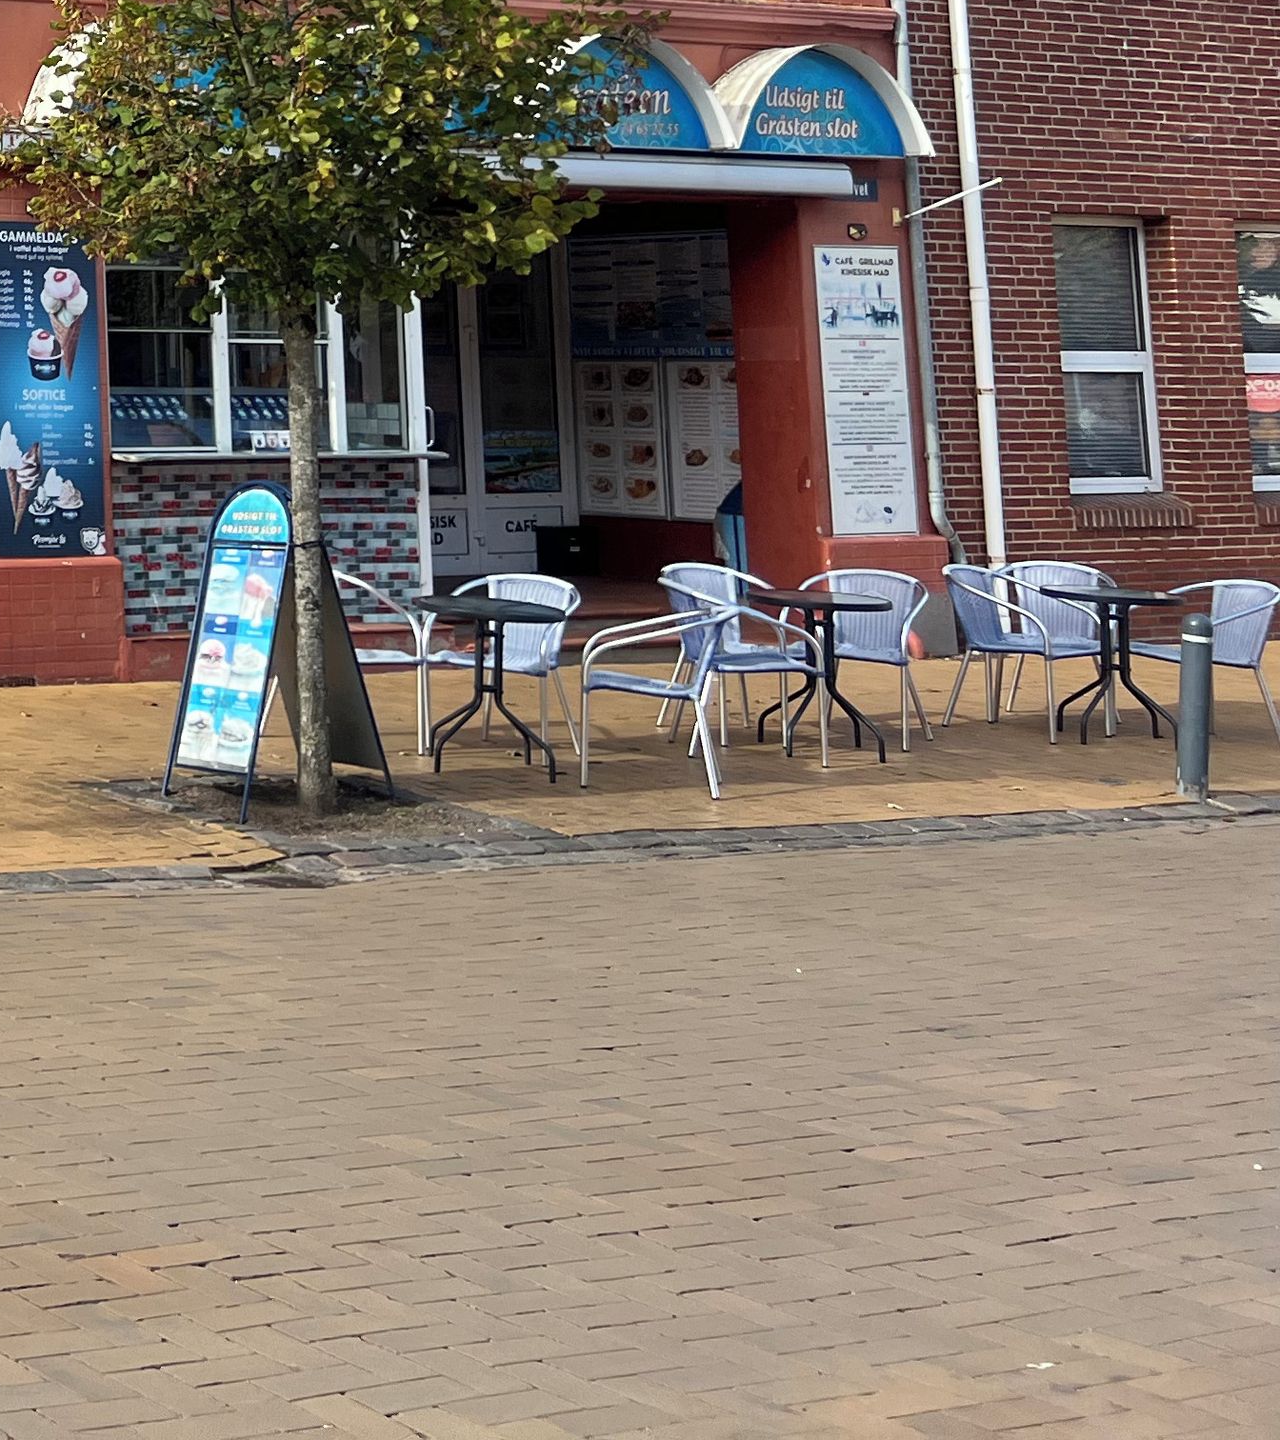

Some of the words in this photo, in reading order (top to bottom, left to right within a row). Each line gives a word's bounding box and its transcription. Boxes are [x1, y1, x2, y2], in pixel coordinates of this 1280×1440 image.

[765, 85, 819, 113] Udsigt
[825, 88, 844, 109] til
[756, 112, 821, 137] Gråsten
[825, 117, 858, 138] slot
[874, 268, 889, 276] MAD
[22, 388, 66, 401] SOFTICE
